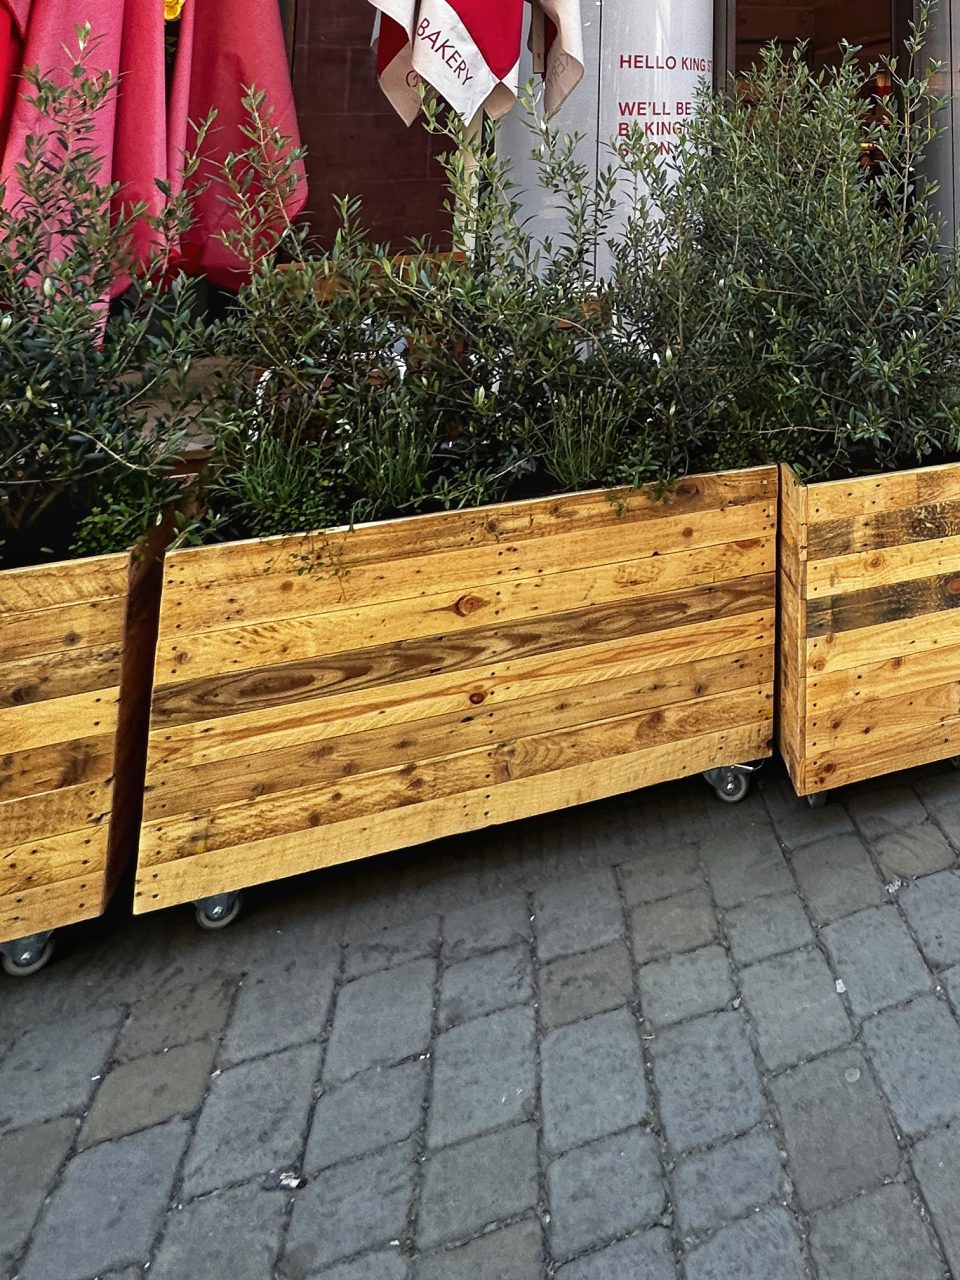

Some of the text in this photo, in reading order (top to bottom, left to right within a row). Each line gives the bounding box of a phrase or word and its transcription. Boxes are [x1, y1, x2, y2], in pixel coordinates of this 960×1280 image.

[416, 17, 474, 86] BAKERY
[619, 54, 677, 70] HELLO
[681, 56, 706, 72] KING
[618, 101, 692, 116] WE'LL BE
[618, 121, 682, 136] BKING
